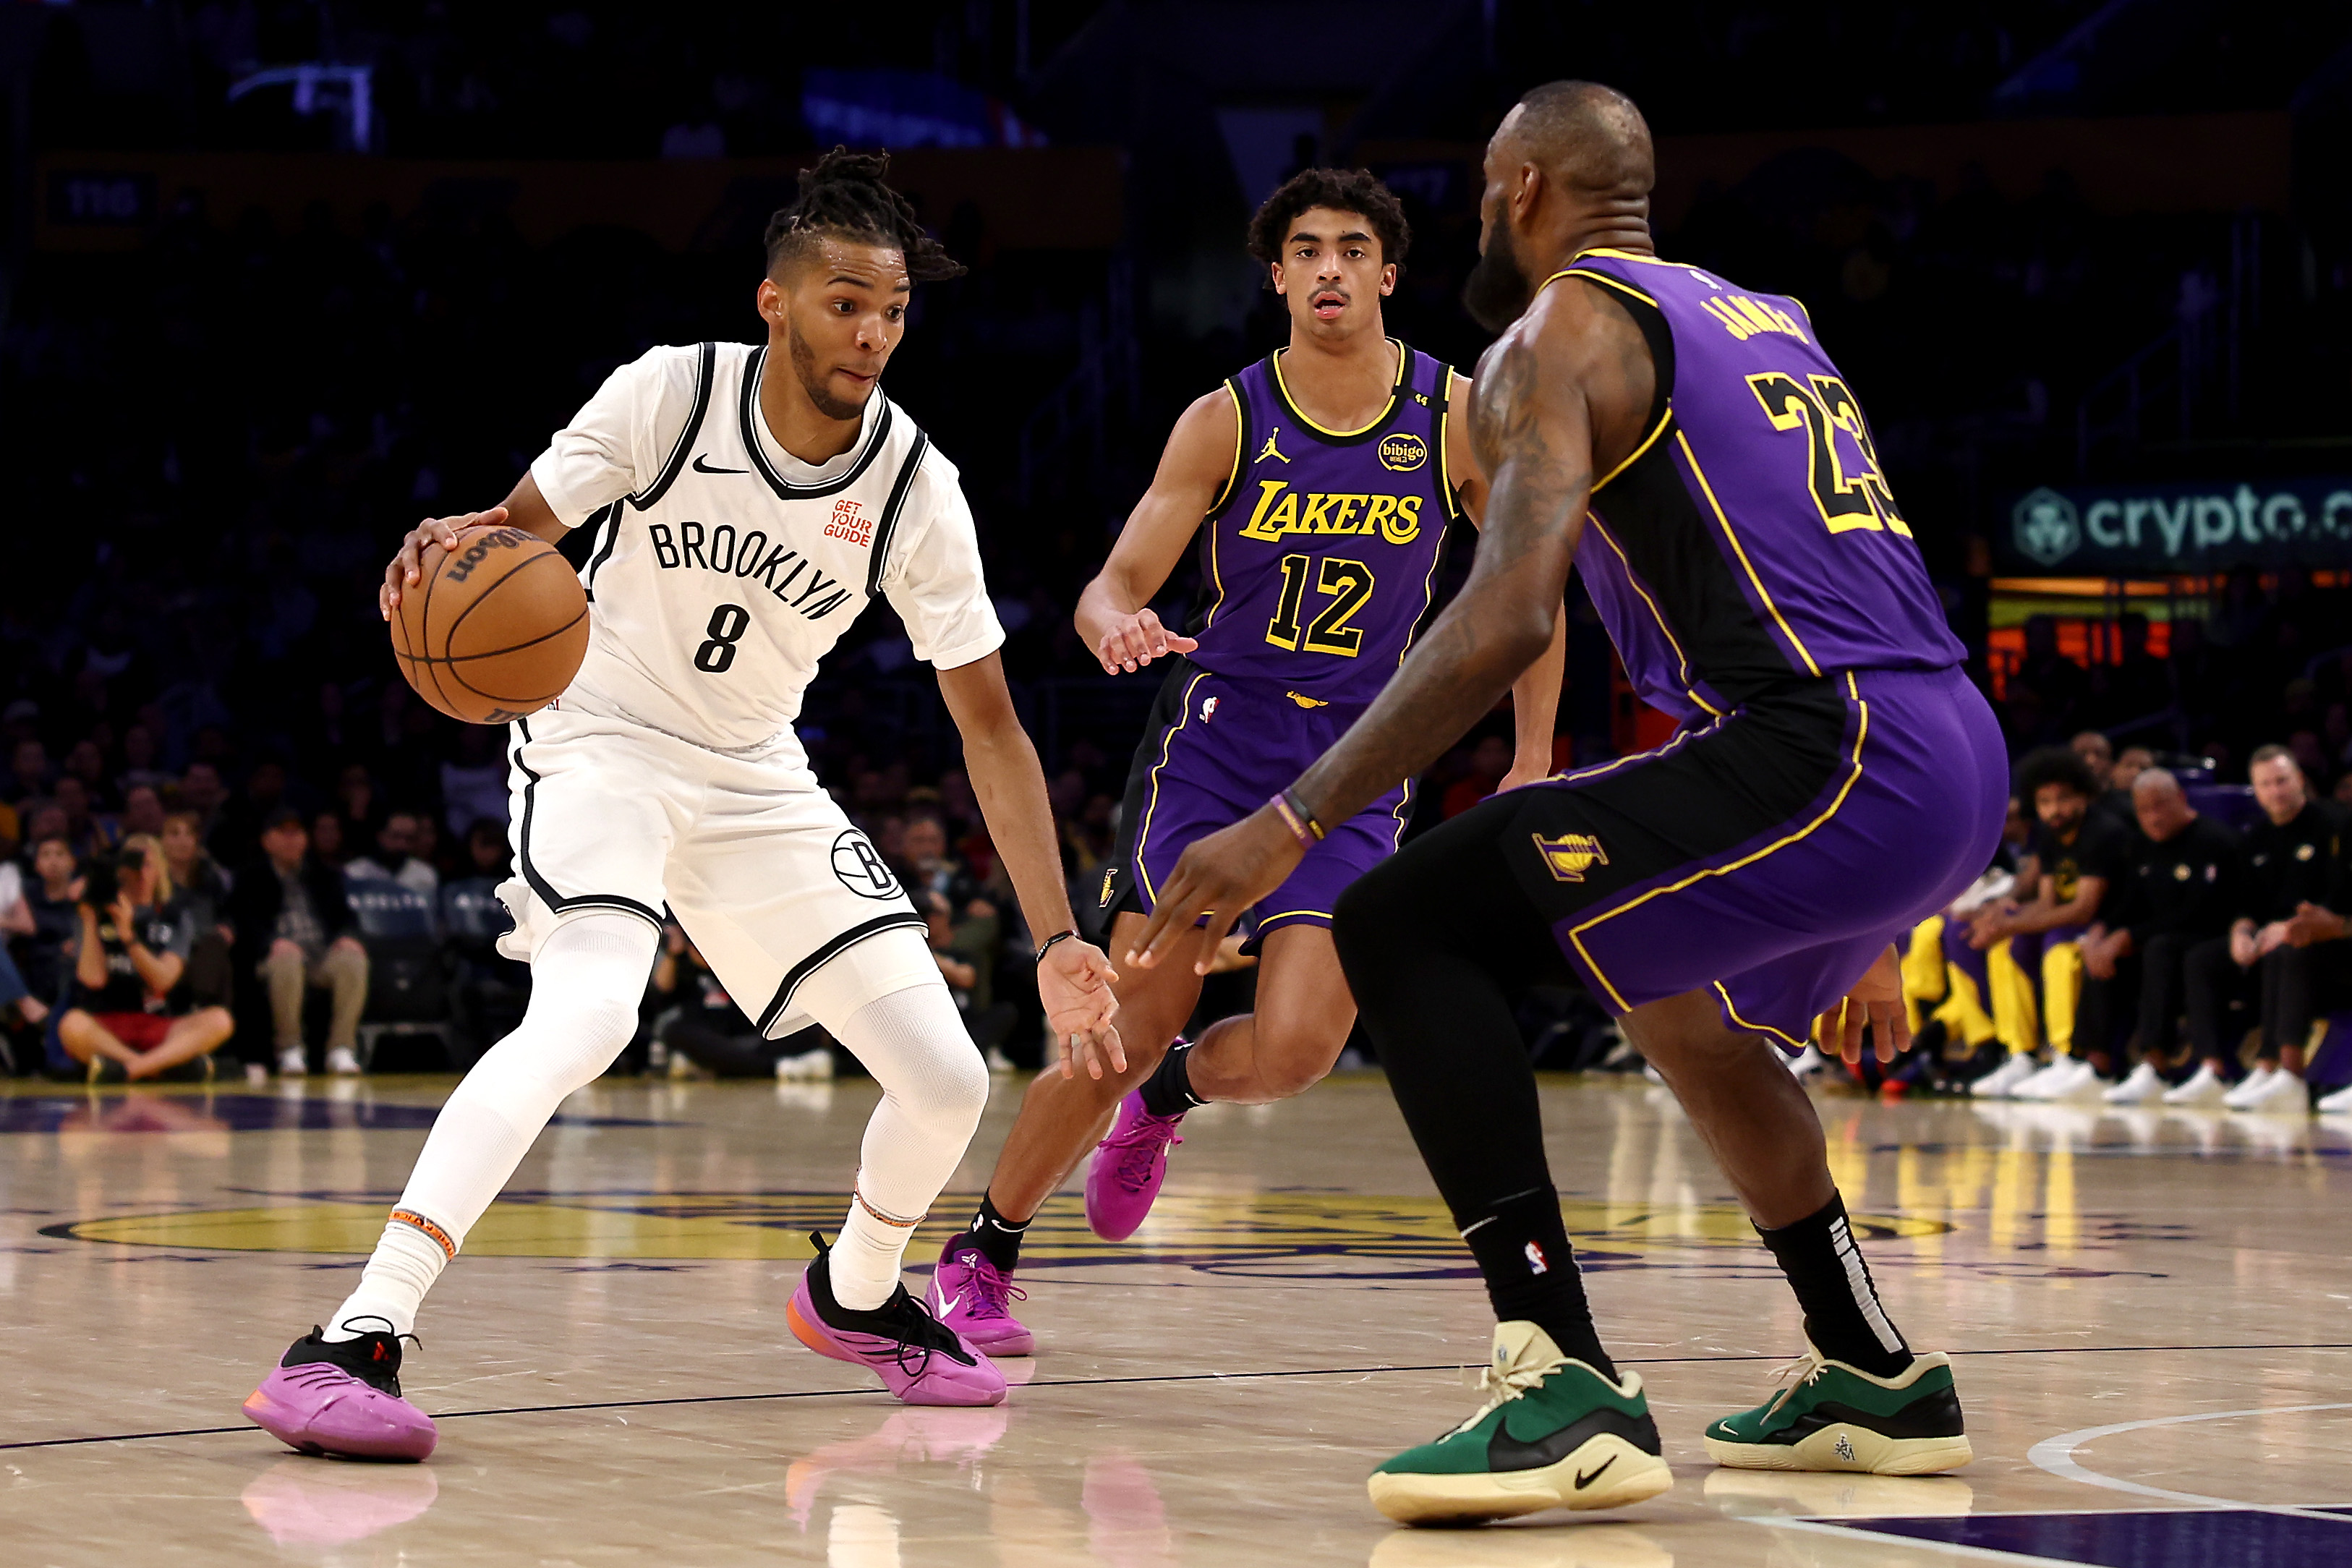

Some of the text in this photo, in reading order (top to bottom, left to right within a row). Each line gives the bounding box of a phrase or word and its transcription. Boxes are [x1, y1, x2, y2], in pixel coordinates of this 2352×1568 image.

[1700, 295, 1810, 345] JAME
[1383, 443, 1425, 461] bibigo
[831, 511, 872, 534] YOUR
[835, 499, 863, 515] GET
[1238, 480, 1423, 545] LAKERS
[824, 524, 872, 548] GUIDE
[648, 521, 853, 621] BROOKLYN
[1265, 553, 1375, 658] 12
[694, 603, 751, 673] 8
[851, 841, 892, 890] B
